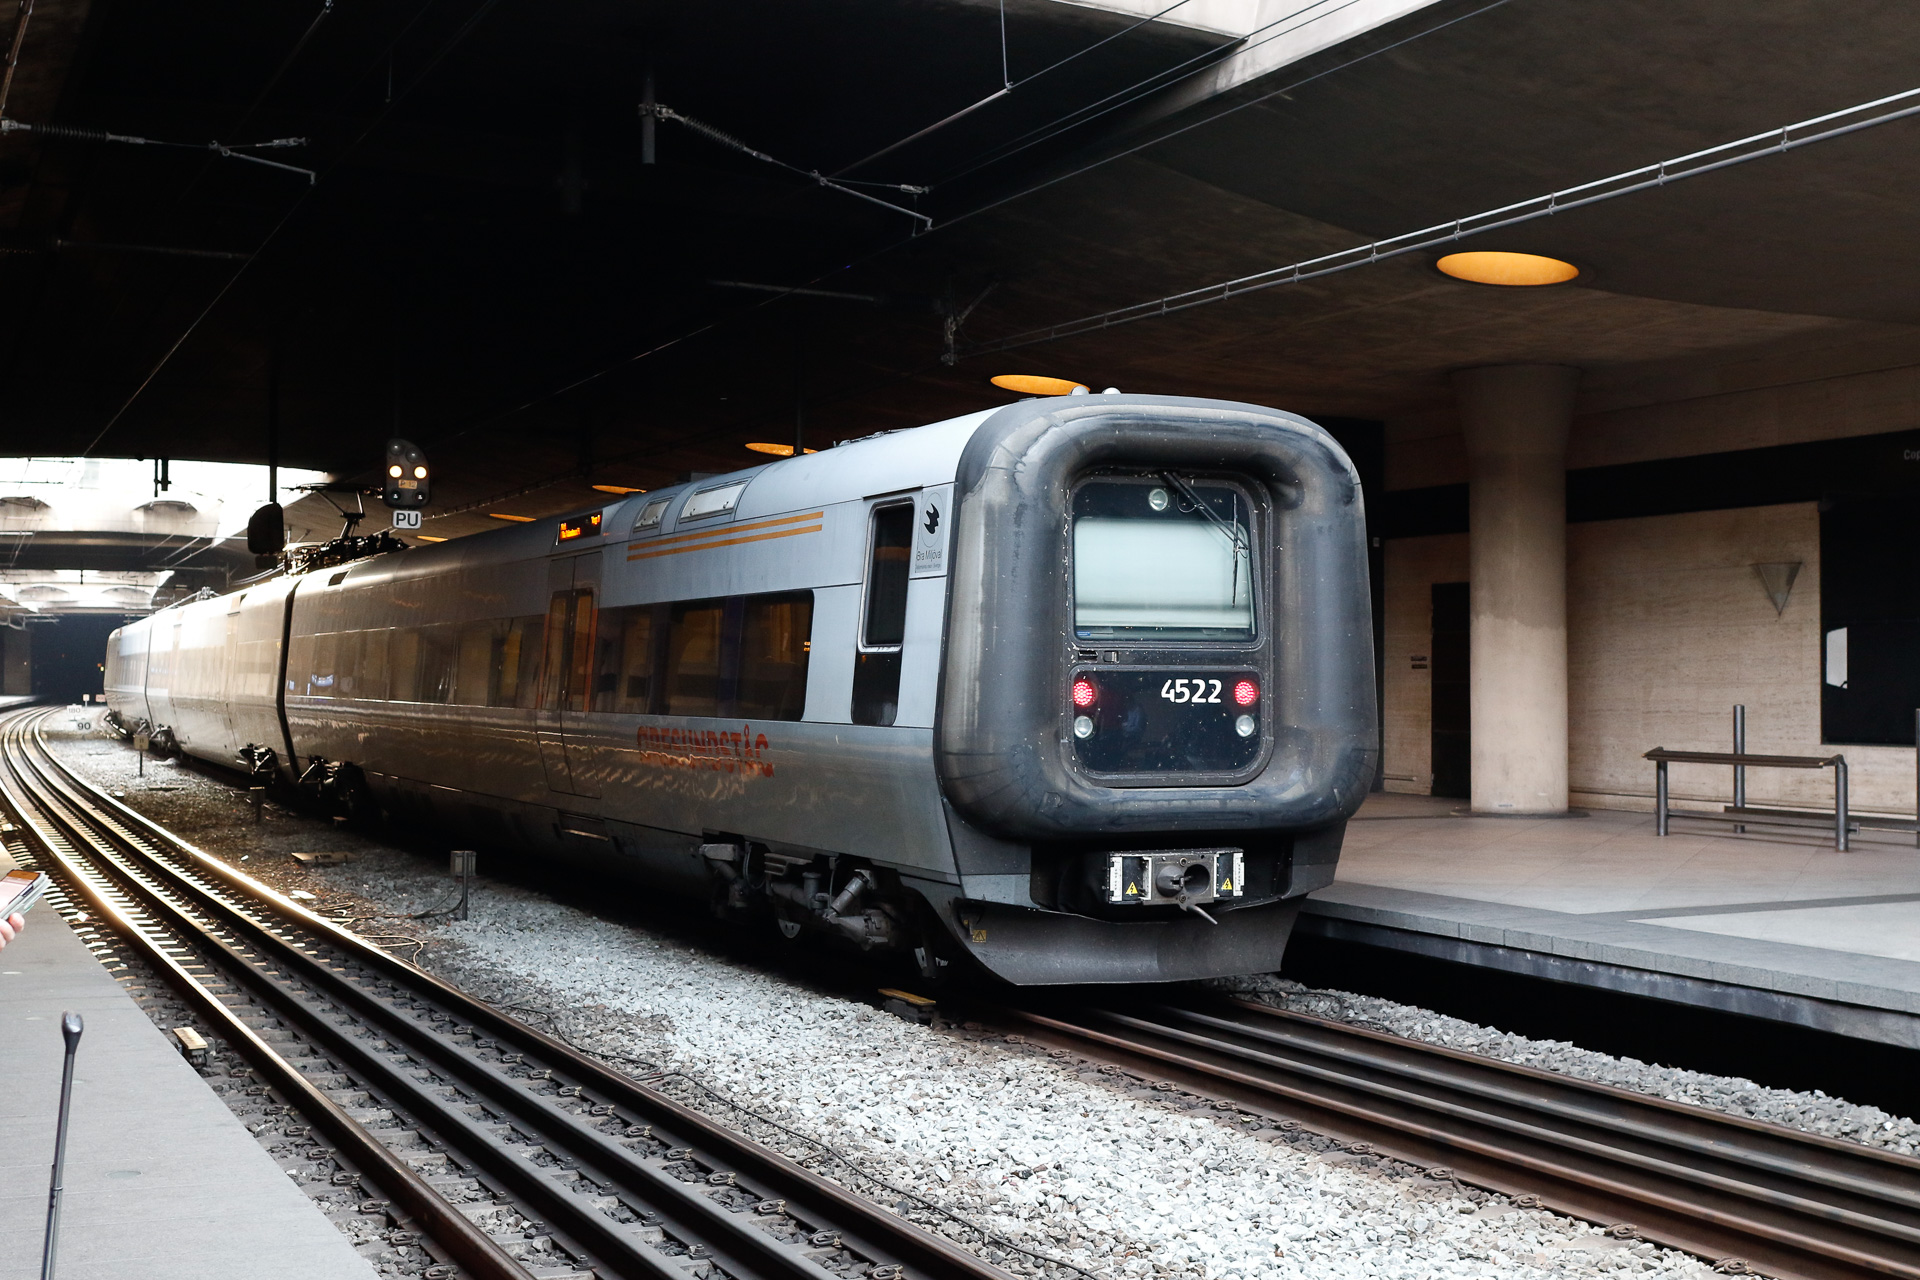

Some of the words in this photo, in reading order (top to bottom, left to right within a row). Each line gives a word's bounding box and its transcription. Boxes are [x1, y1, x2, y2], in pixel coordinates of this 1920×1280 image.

[396, 512, 419, 527] PU
[1160, 678, 1222, 704] 4522
[77, 722, 91, 731] 90
